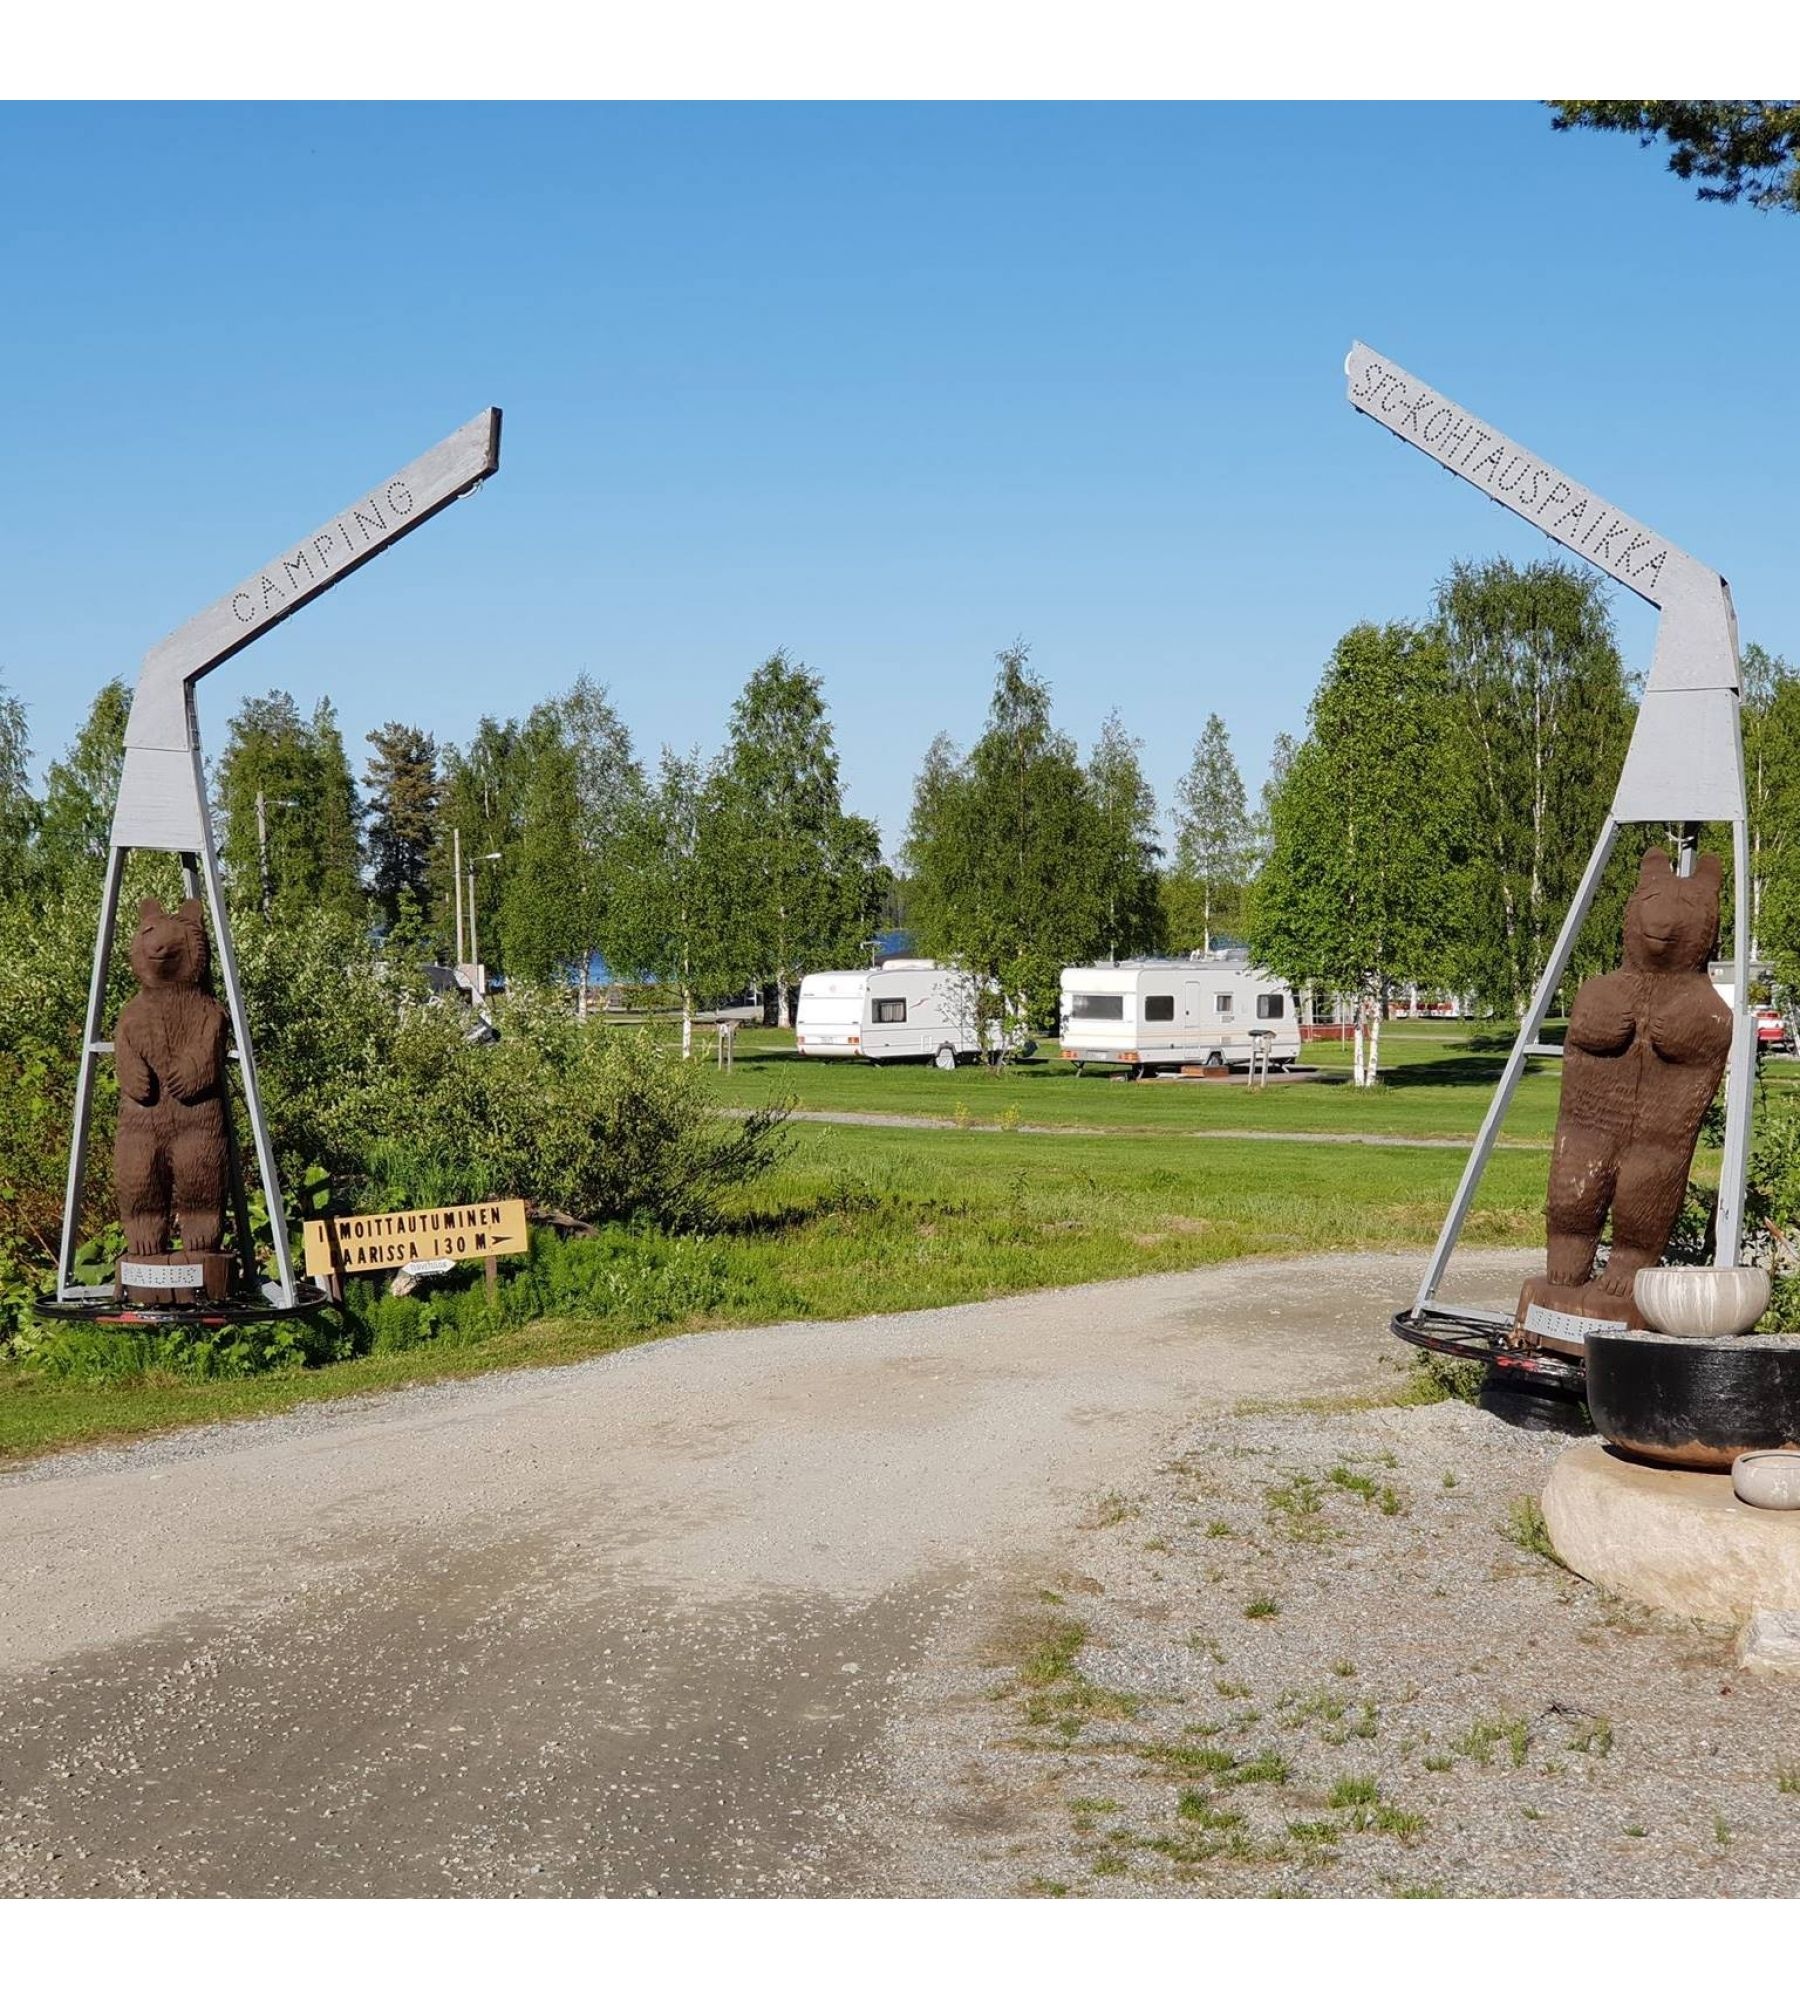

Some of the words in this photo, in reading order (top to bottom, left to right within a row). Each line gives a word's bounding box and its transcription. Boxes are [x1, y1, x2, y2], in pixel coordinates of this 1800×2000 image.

[1353, 363, 1669, 589] SFC-KOHTAUSPAIKKA
[231, 480, 414, 623] CAMPING
[434, 1236, 466, 1256] 130
[475, 1232, 487, 1250] M
